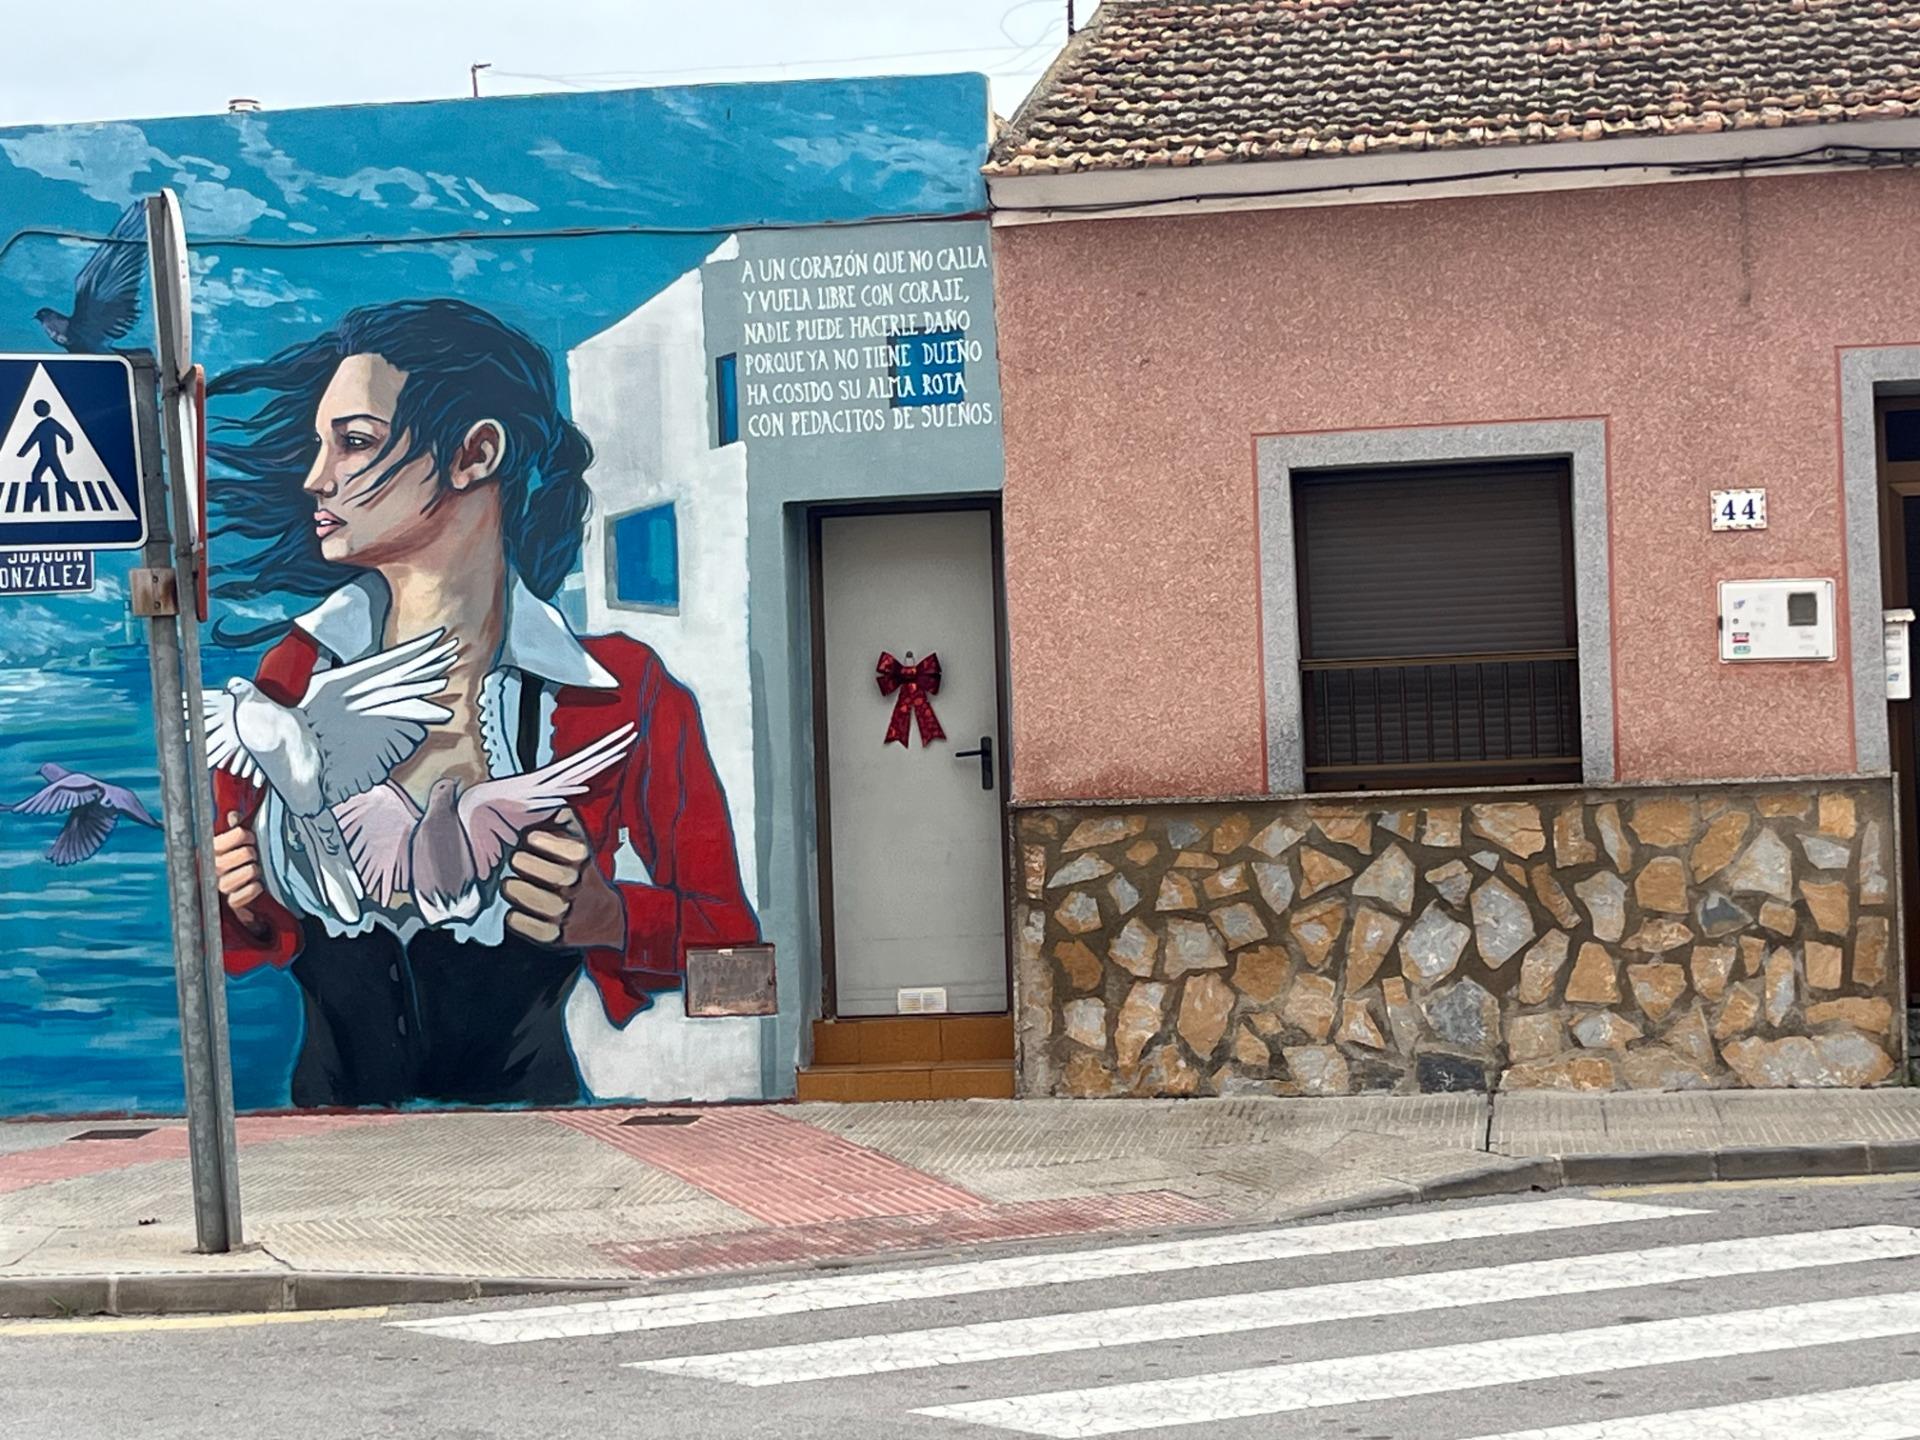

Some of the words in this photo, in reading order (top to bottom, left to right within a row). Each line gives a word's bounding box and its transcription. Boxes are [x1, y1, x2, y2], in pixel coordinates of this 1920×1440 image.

[741, 260, 756, 283] A
[759, 259, 785, 282] UN
[789, 250, 868, 280] CORAZÓN
[873, 252, 905, 275] QUE
[909, 250, 933, 273] NO
[937, 245, 988, 270] CALLA
[743, 292, 755, 314] Y
[758, 288, 812, 312] VUELA
[817, 286, 856, 310] LIBRE
[860, 283, 894, 307] CON
[899, 277, 970, 304] CORAJE,
[744, 321, 790, 345] NADIE
[796, 317, 844, 341] PUEDE
[850, 313, 917, 338] HACERLE
[924, 308, 970, 333] DAÑO
[745, 351, 805, 375] PORQUE
[808, 350, 827, 371] YA
[833, 348, 859, 370] NO
[863, 344, 912, 369] TIENE
[922, 339, 983, 365] DUEÑO
[747, 384, 769, 406] HA
[773, 380, 833, 404] COSIDO
[839, 379, 860, 399] SU
[867, 375, 916, 399] ALMA
[922, 372, 968, 395] ROTA
[749, 411, 784, 437] CON
[791, 408, 885, 436] PEDACITOS
[893, 406, 914, 430] DE
[1722, 499, 1756, 520] 44
[0, 563, 86, 589] ONZÁLEZ
